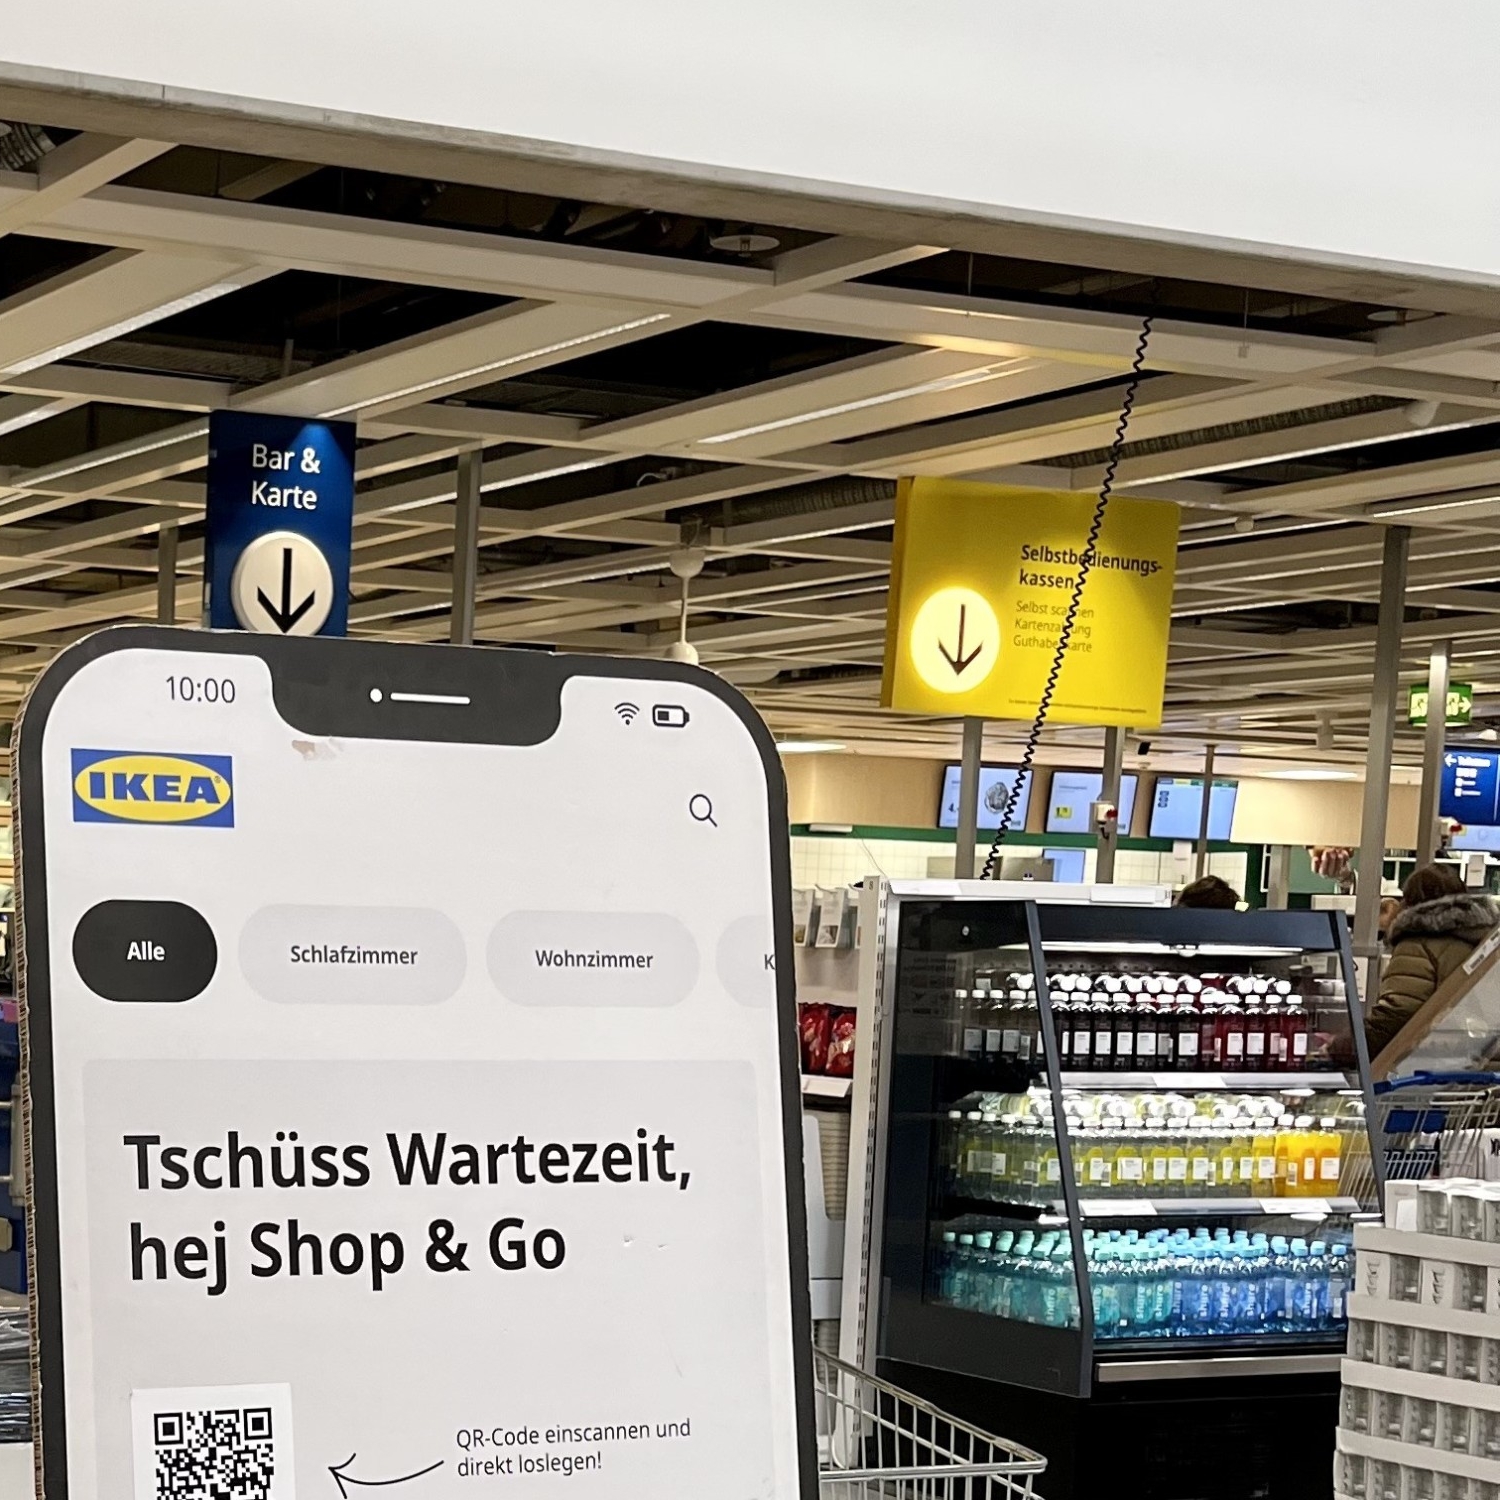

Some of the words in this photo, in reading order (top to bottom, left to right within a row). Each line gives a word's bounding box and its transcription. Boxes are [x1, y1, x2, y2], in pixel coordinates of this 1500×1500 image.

[253, 444, 295, 470] Bar
[301, 447, 320, 473] &
[252, 482, 317, 509] Karte
[1019, 568, 1074, 589] kassen
[1016, 600, 1048, 614] Selbst
[1051, 606, 1094, 619] scanen
[1015, 618, 1091, 638] Kartenzaung
[1013, 635, 1092, 652] Guthabearte
[167, 676, 235, 703] 10:00
[89, 771, 221, 804] IKEA
[127, 941, 165, 960] Alle
[291, 945, 417, 964] Schlafzimmer
[536, 950, 653, 968] Wohnzimmer
[123, 1131, 370, 1189] Tschüss
[386, 1128, 690, 1190] Wartezeit,
[131, 1221, 226, 1296] hej
[251, 1219, 404, 1291] Shop
[426, 1219, 470, 1272] &
[489, 1218, 565, 1270] Go
[457, 1426, 539, 1451] QR-Code
[546, 1425, 649, 1443] einscannen
[657, 1418, 690, 1438] und
[458, 1456, 513, 1476] direkt
[519, 1451, 601, 1476] loslegen!
